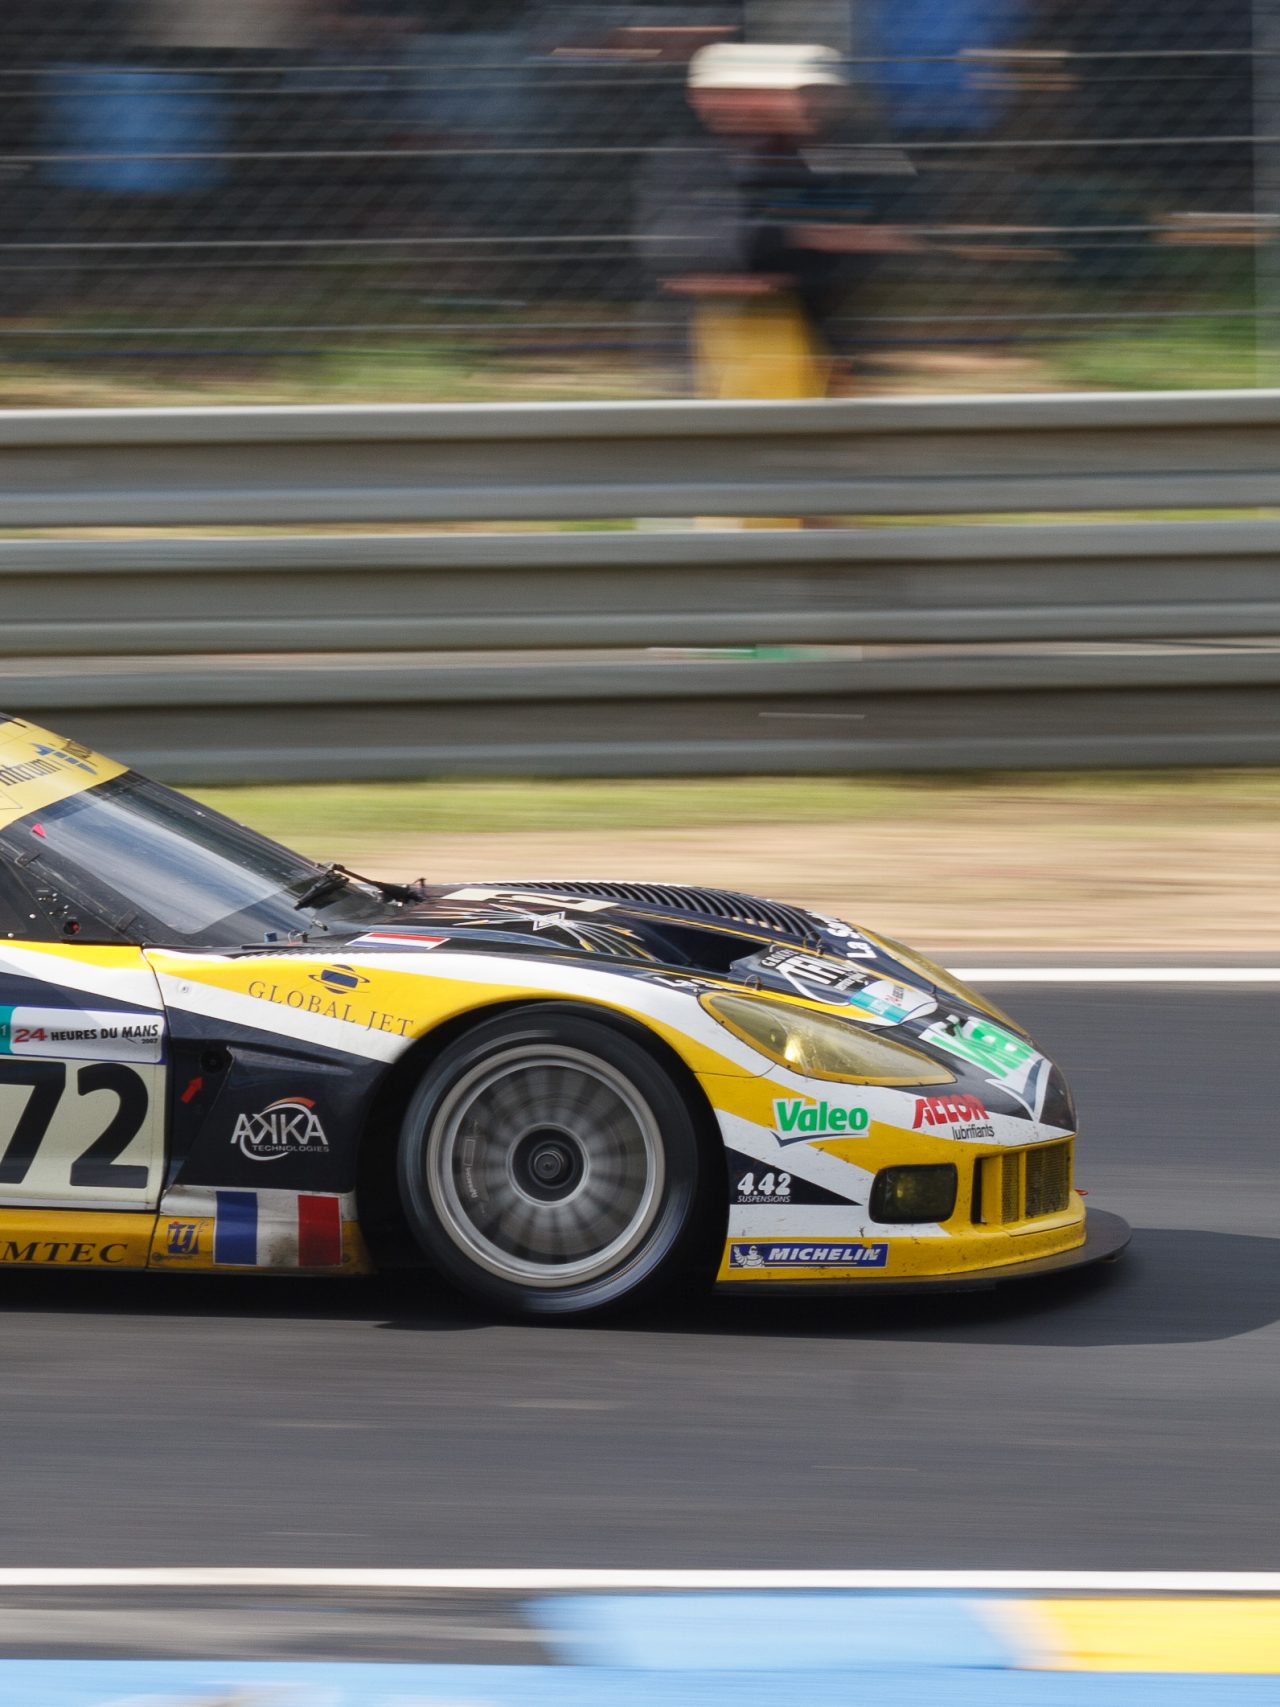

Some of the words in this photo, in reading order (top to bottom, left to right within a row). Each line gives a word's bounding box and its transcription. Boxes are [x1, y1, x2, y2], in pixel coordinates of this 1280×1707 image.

[248, 980, 357, 1024] GLOBAL
[365, 1010, 414, 1037] JET
[13, 1027, 48, 1044] 24
[50, 1028, 98, 1041] HEURES
[100, 1026, 119, 1039] DU
[121, 1023, 159, 1039] MANS
[776, 1100, 869, 1132] Valeo
[912, 1095, 990, 1129] ACCOR
[230, 1113, 329, 1145] AKKA
[952, 1124, 995, 1141] lubrifiants
[252, 1144, 330, 1153] TECHNOLOGIES
[737, 1172, 792, 1196] 4.42
[737, 1195, 792, 1203] SUSPENSIONS
[769, 1247, 881, 1262] MICHELIN
